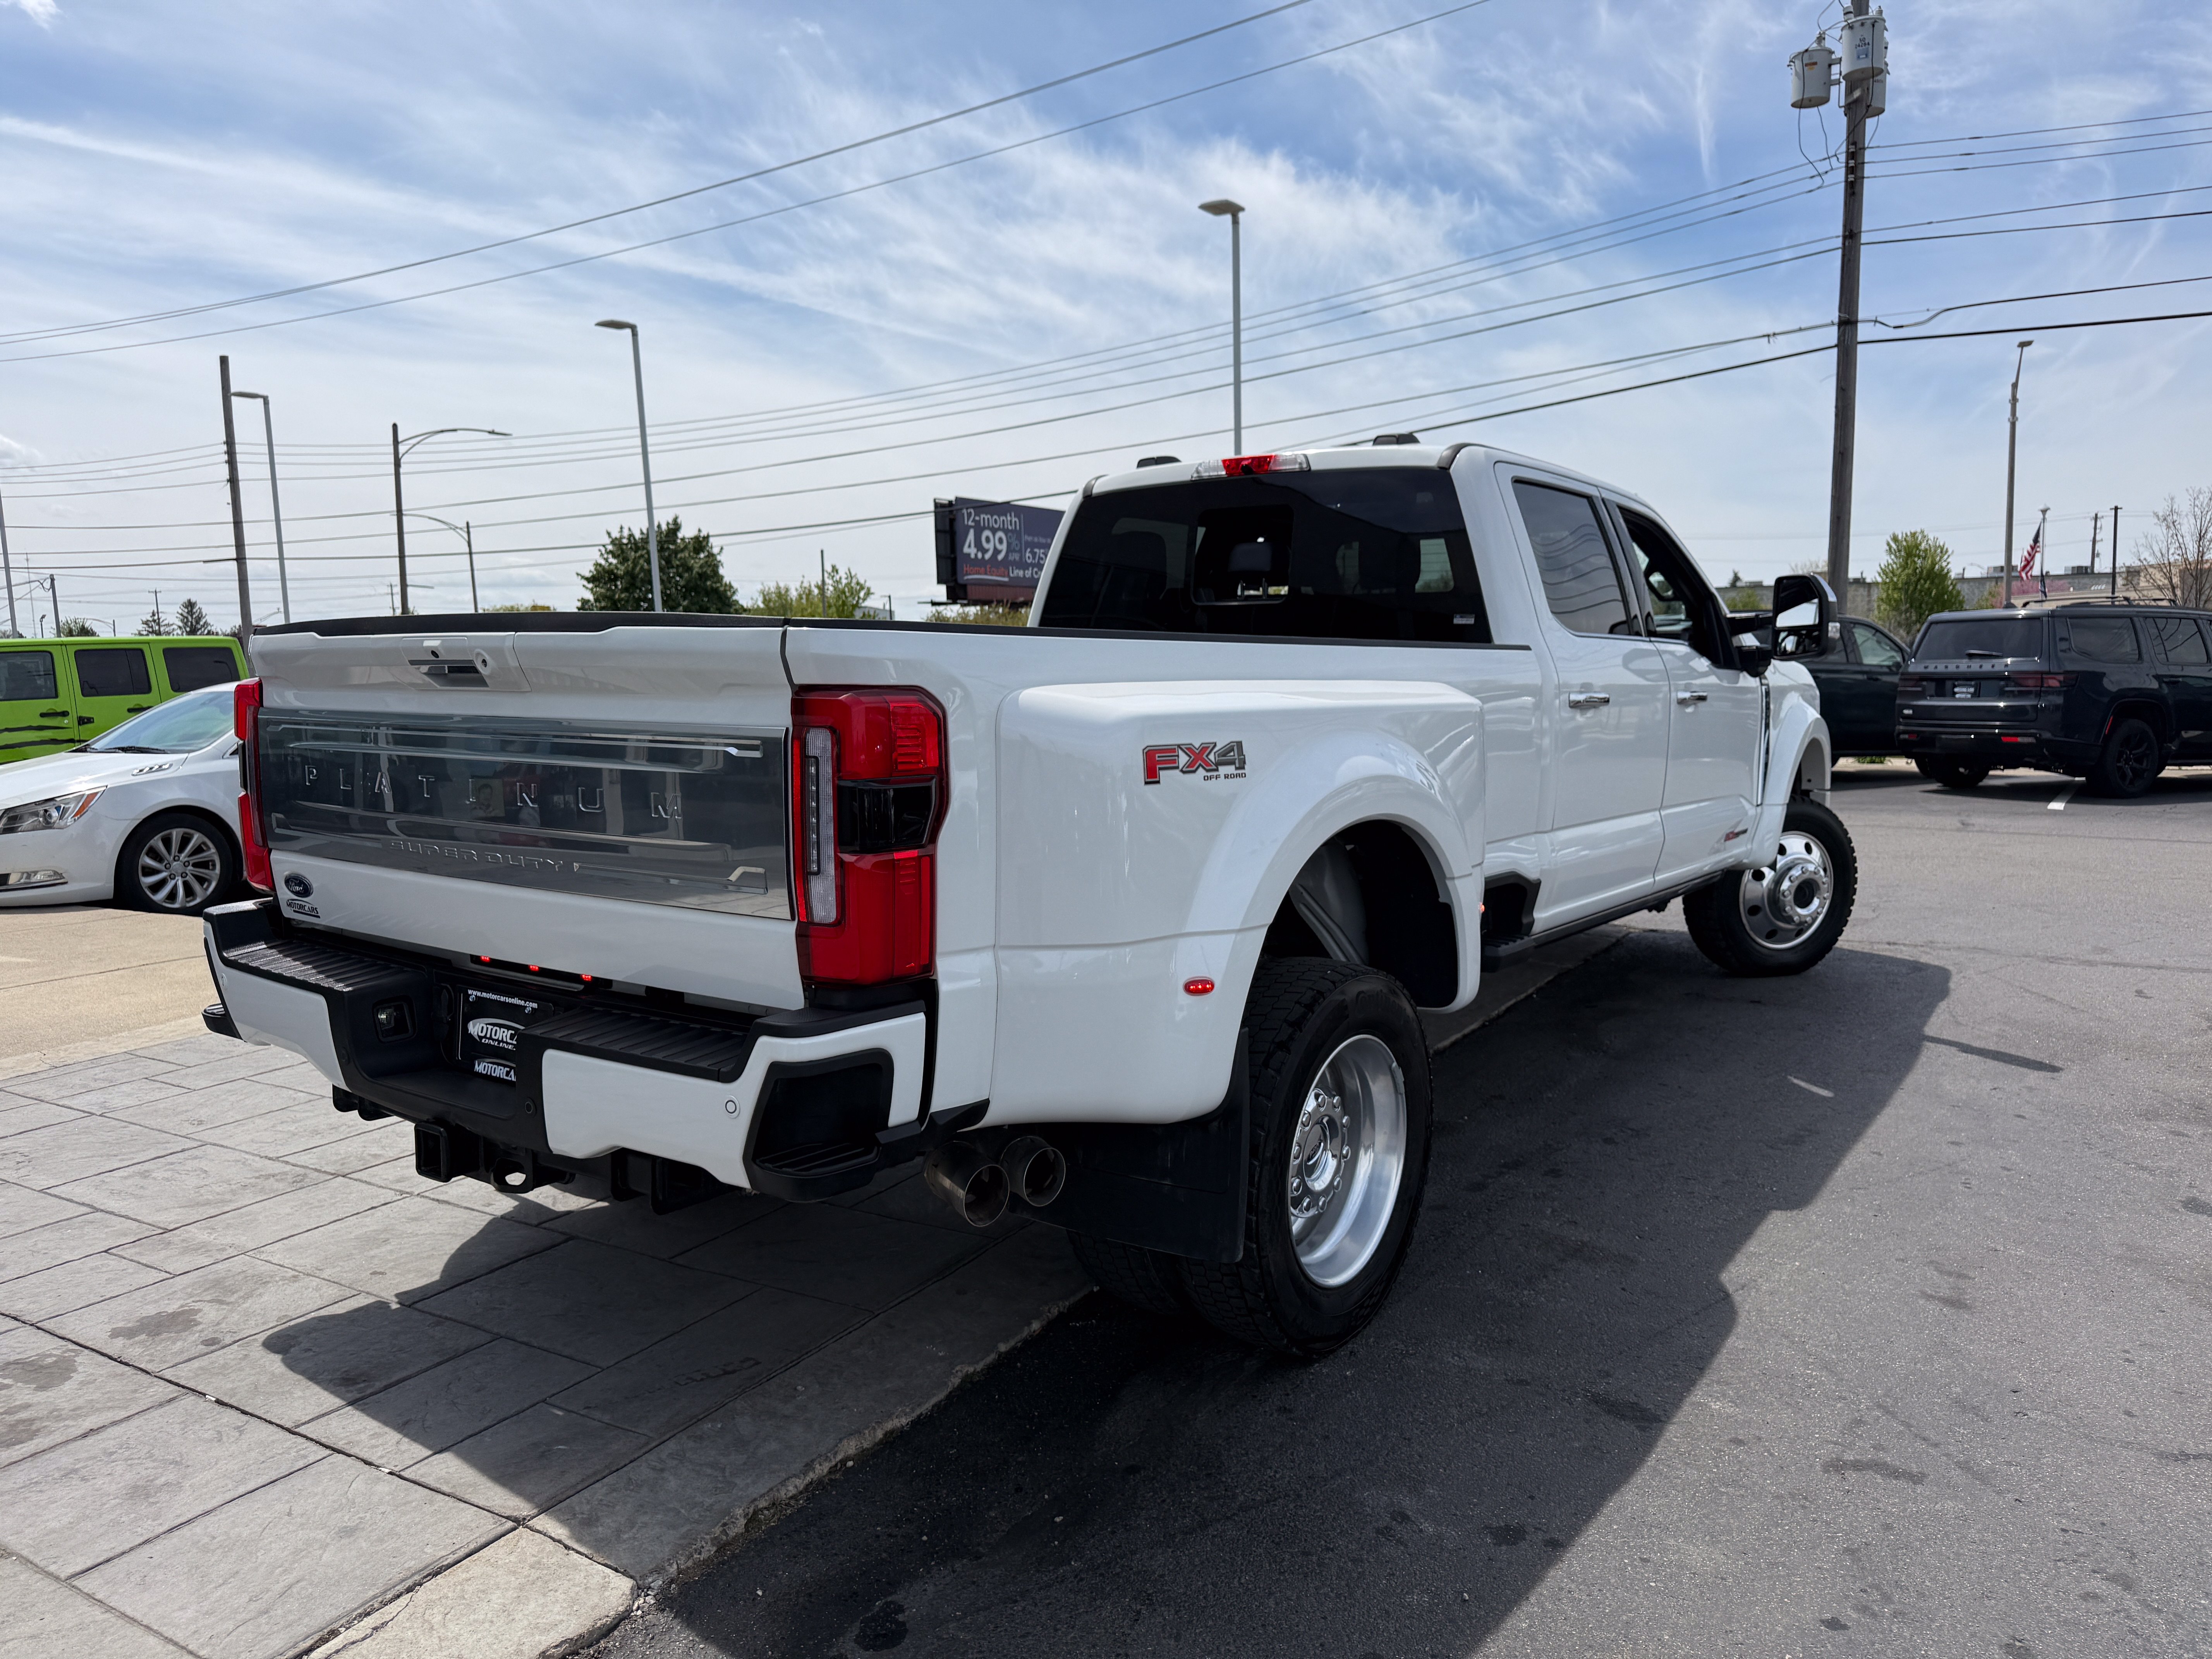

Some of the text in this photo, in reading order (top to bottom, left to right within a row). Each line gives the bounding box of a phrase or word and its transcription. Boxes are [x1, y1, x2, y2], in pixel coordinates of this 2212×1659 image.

[962, 508, 1019, 531] 12-month
[1025, 548, 1048, 564] 6.75
[963, 564, 985, 575] Home
[987, 565, 1008, 577] Equity
[1009, 566, 1024, 578] Line
[1025, 567, 1032, 578] of
[1143, 740, 1246, 786] FX4
[305, 765, 682, 819] PLATINUM
[392, 841, 564, 872] SUPER DUTY
[286, 900, 319, 914] MOTORCARS
[468, 989, 538, 1008] www.motorcarsonline.com
[474, 1060, 516, 1082] MOTORCA
